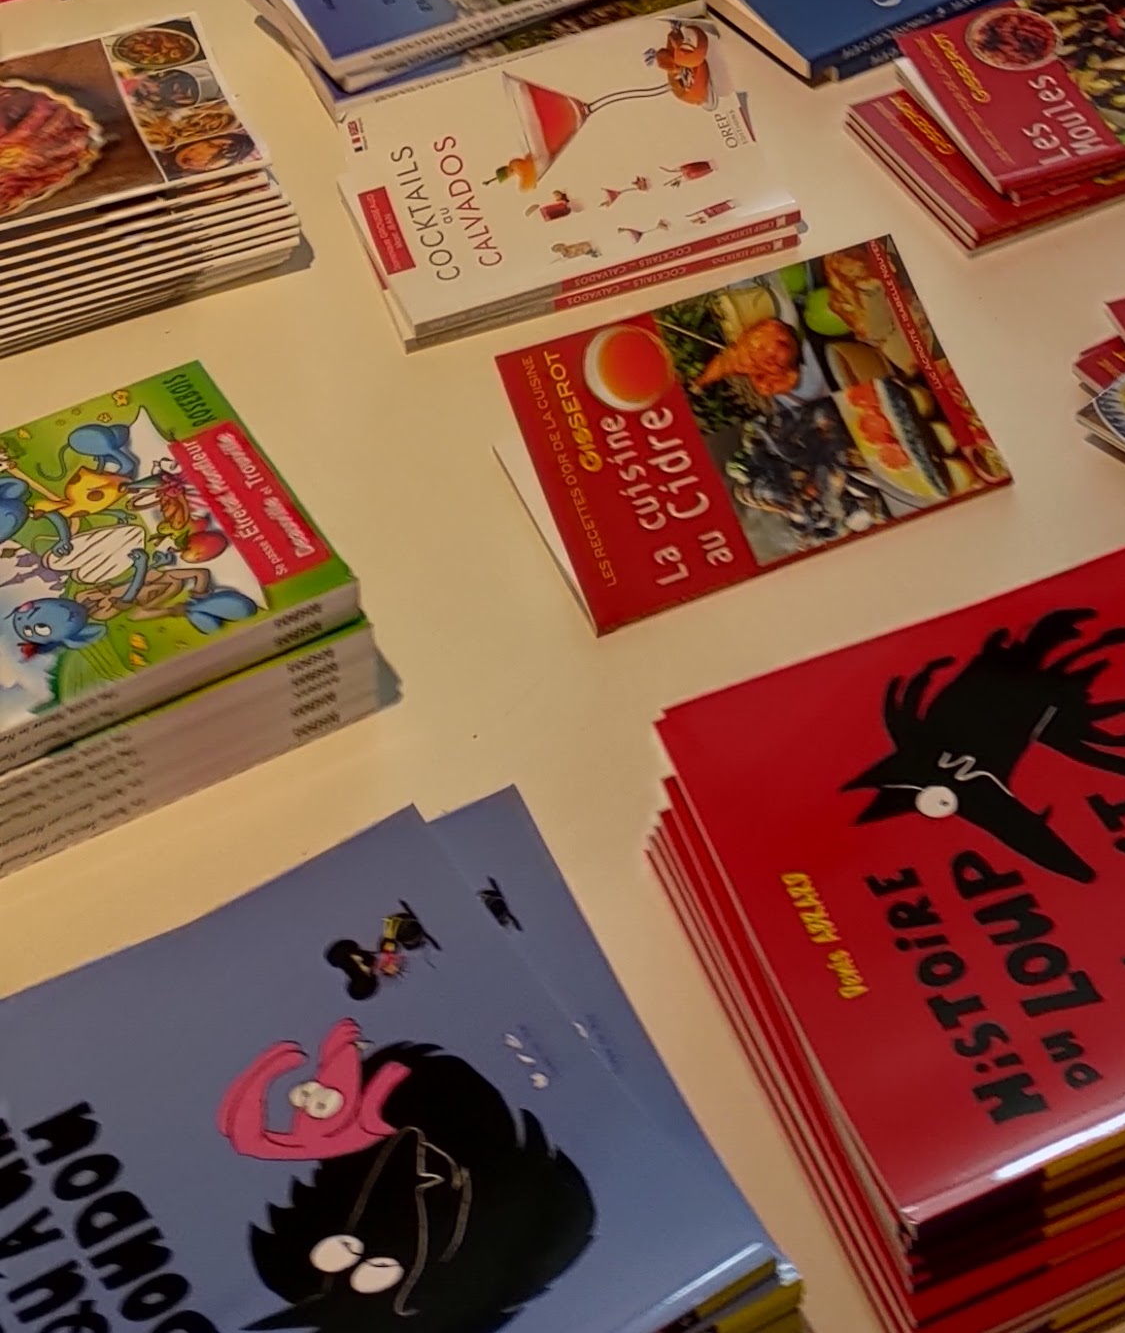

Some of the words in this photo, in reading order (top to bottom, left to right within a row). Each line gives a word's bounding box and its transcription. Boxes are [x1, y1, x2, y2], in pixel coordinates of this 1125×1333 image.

[712, 113, 739, 150] OREP
[1029, 75, 1114, 157] Moules
[1022, 123, 1073, 166] Les
[390, 144, 461, 283] COCKTAILS
[433, 135, 503, 269] CALVADOS
[437, 206, 454, 226] au
[564, 283, 621, 308] CALVADOS
[631, 264, 688, 289] COCKTAILS
[162, 374, 219, 428] ROSEBOIS
[521, 354, 549, 411] CUISINE
[543, 350, 604, 473] GISSEROT
[543, 412, 557, 432] LA
[549, 432, 564, 452] DE
[639, 406, 710, 520] Cidre
[569, 487, 609, 558] RECETTES
[653, 545, 690, 586] La
[698, 530, 735, 567] au
[599, 556, 618, 587] LES
[951, 849, 1105, 1019] LOUP
